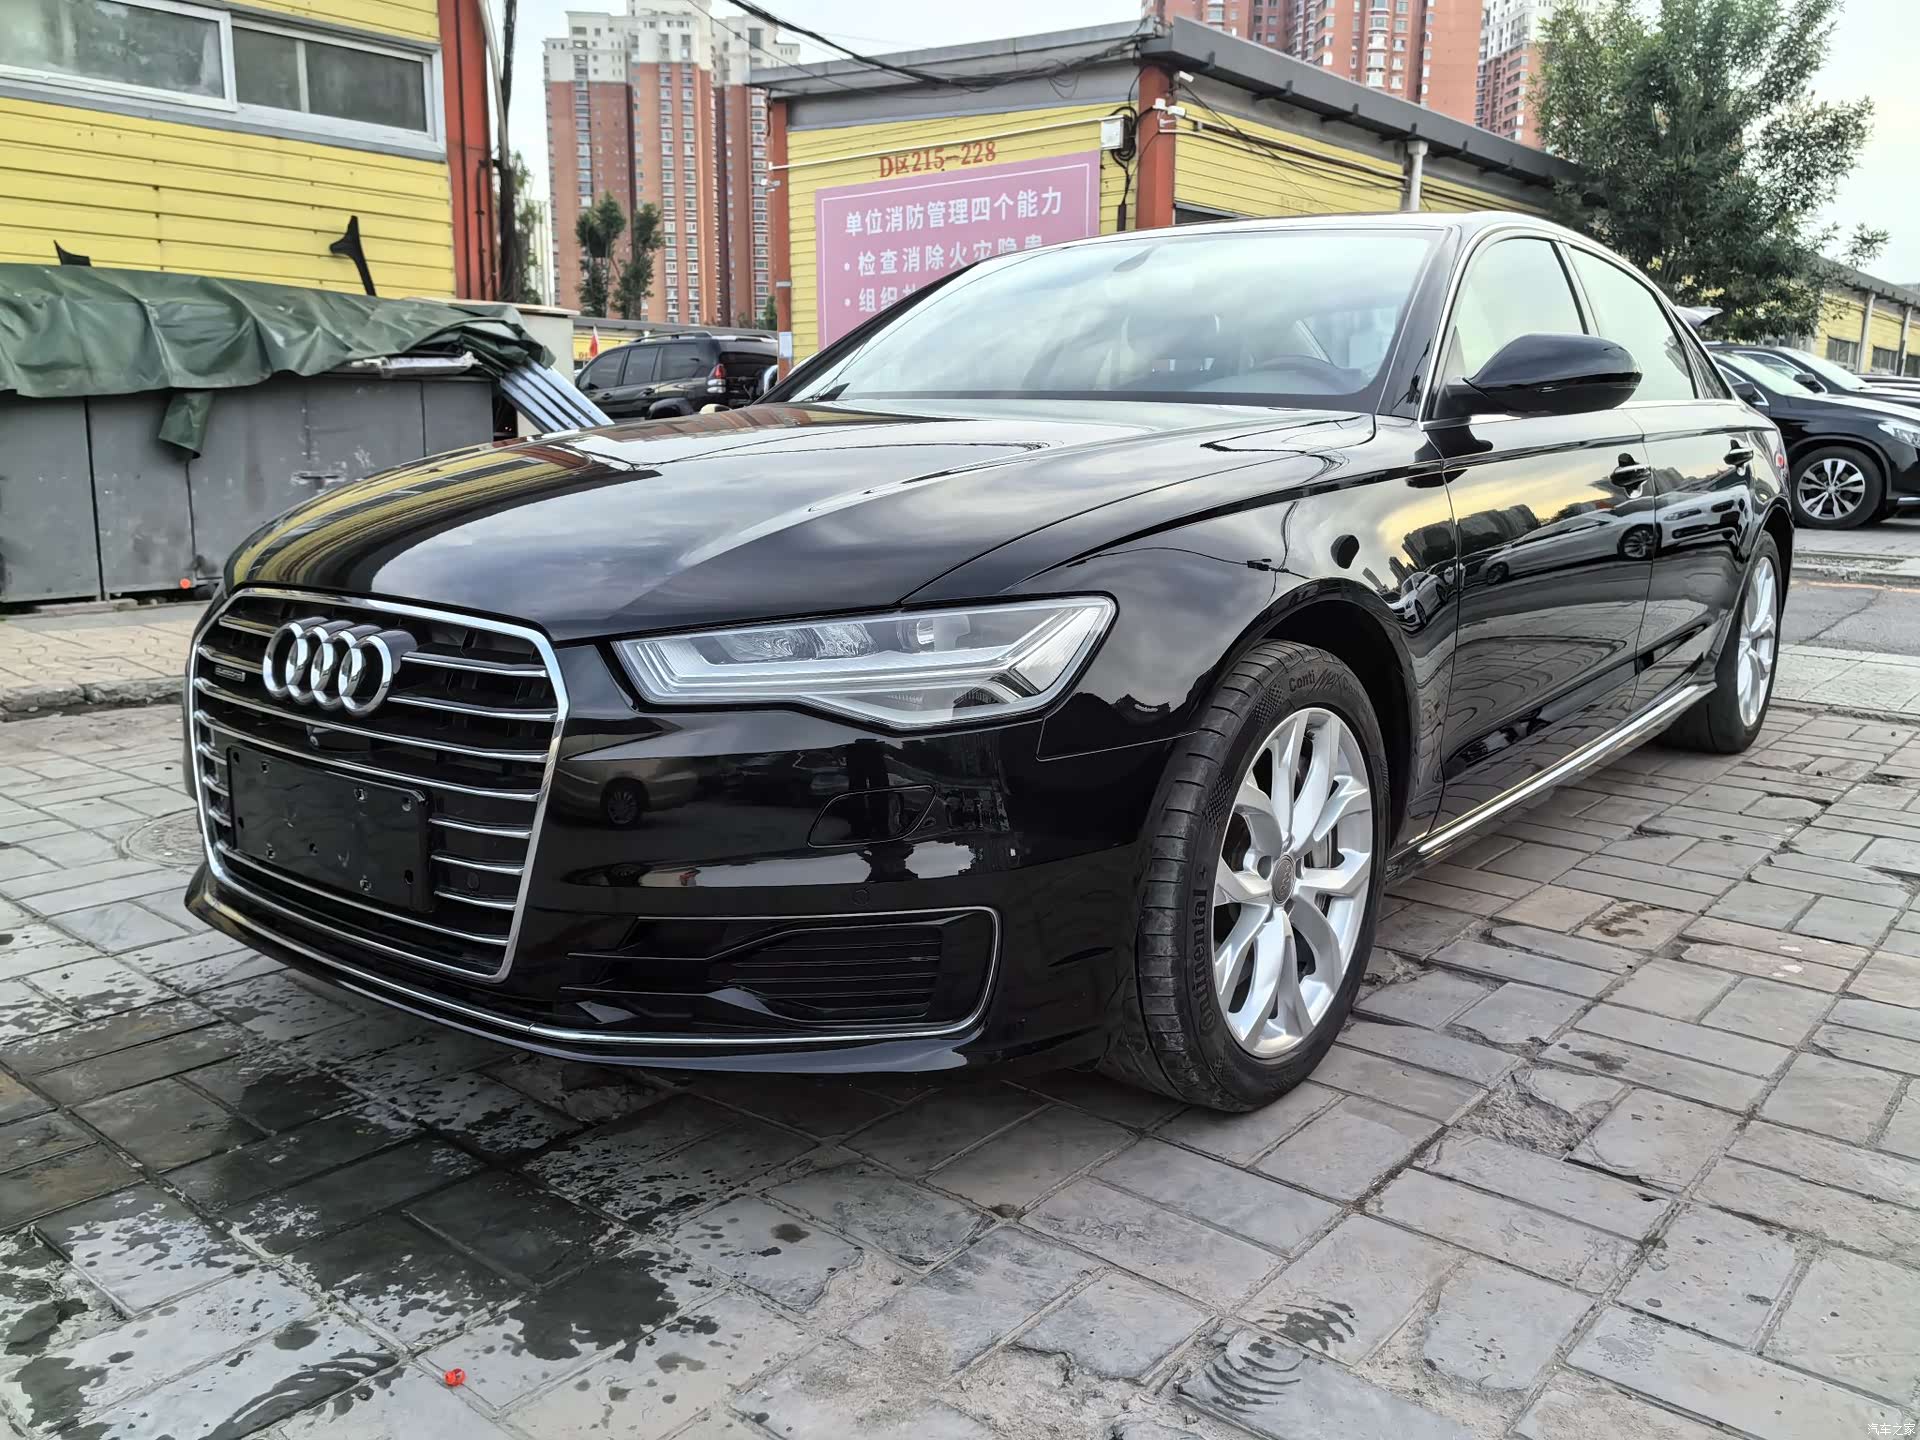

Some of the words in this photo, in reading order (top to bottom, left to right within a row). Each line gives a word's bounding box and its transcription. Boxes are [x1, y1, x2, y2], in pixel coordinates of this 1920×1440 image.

[845, 186, 1062, 237] 单位消防管理四个能力
[1191, 888, 1216, 1037] Continental
